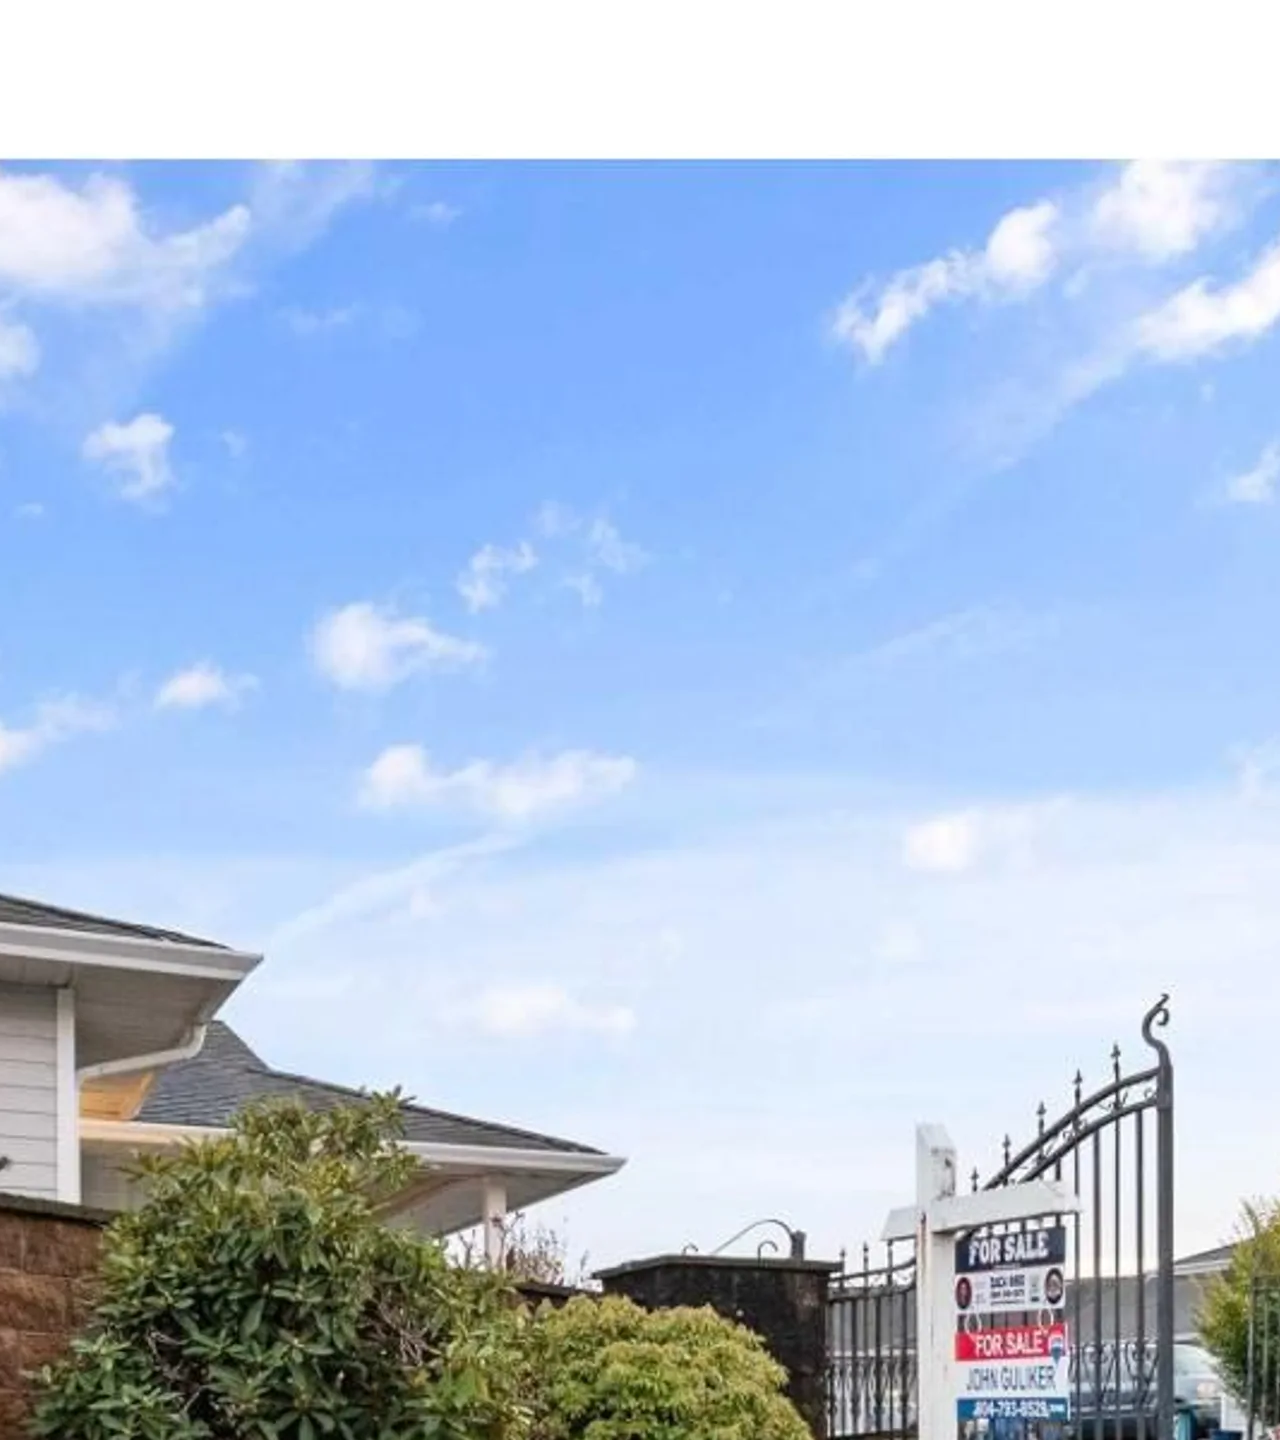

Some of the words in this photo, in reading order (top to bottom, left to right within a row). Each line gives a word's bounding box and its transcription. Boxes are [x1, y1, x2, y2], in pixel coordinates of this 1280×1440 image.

[969, 1237, 1001, 1266] FOR
[1004, 1231, 1049, 1262] SALE
[975, 1333, 1003, 1358] FOR
[1006, 1330, 1044, 1356] SALE
